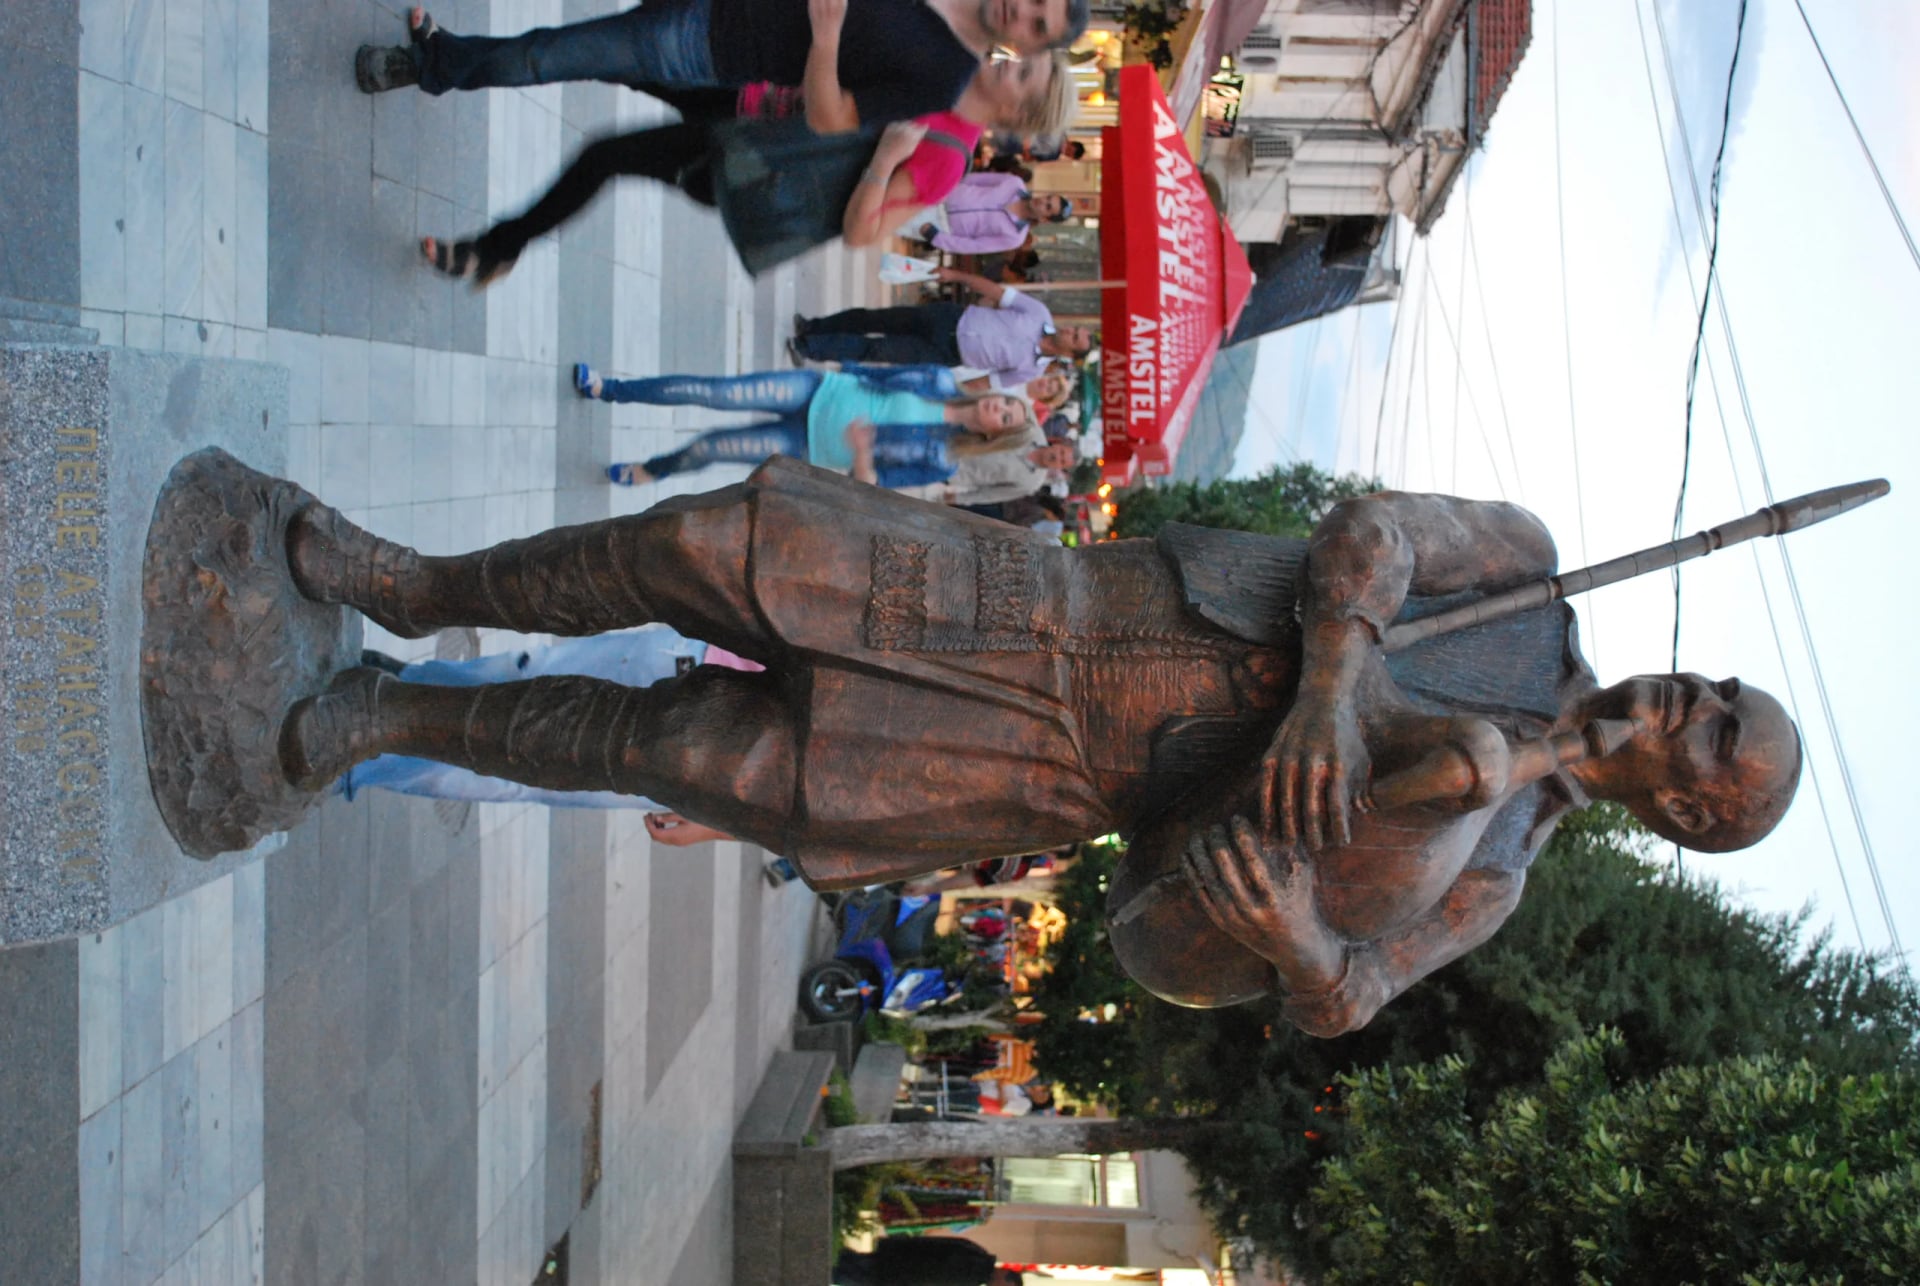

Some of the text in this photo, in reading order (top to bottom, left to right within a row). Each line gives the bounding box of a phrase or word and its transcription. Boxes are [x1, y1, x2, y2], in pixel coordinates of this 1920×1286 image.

[1152, 100, 1179, 308] AMSTEL
[1171, 149, 1194, 309] AMSTEL
[1104, 349, 1127, 447] AMSTEL
[1130, 314, 1158, 425] AMSTEL
[1160, 311, 1173, 407] AMSTEL
[51, 427, 100, 551] ПЕЦЕ
